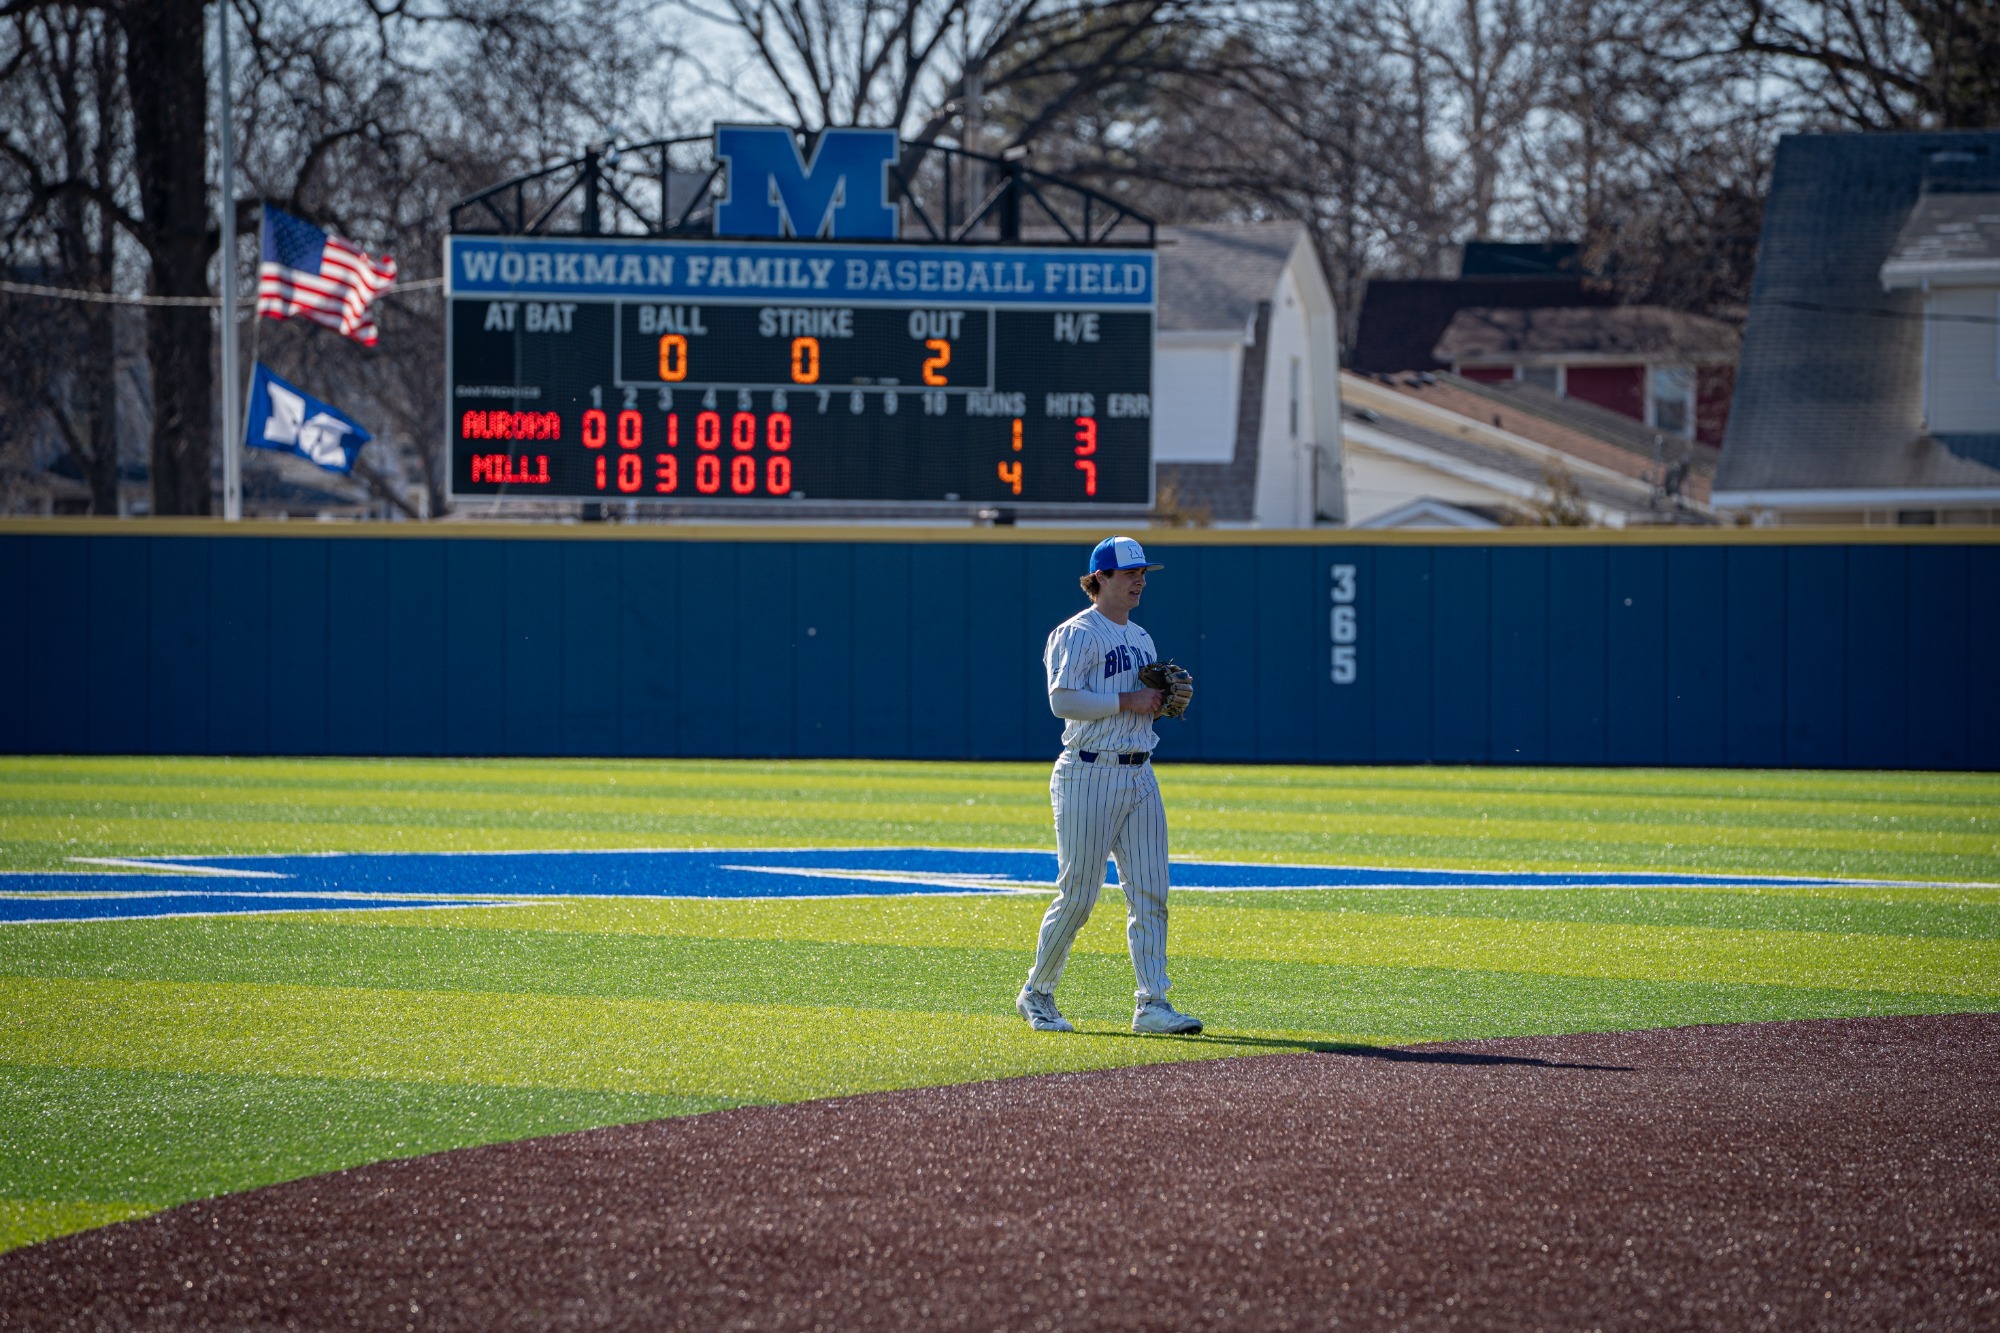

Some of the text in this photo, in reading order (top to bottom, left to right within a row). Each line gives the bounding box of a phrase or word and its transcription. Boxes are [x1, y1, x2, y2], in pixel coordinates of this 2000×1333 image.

[712, 123, 899, 239] M
[462, 251, 1148, 295] WORKMAN FAMILY BASEBALL FIELD
[484, 301, 577, 333] AT BAT
[638, 305, 708, 335] BALL
[758, 307, 854, 338] STRIKE
[908, 309, 965, 340] OUT
[1054, 312, 1100, 344] H/E
[658, 333, 688, 382] 0
[791, 336, 820, 385] 0
[922, 338, 951, 387] 2
[590, 385, 948, 416] 1 2 3 4 5 6 7 8 9 10
[965, 391, 1026, 417] RUNS
[1046, 392, 1096, 418] HITS
[1107, 393, 1150, 418] ERR
[463, 410, 560, 440] AURORA
[582, 408, 792, 451] 0 0 1 0 0 0
[1012, 418, 1023, 451] 1
[1074, 416, 1097, 456] 3
[596, 453, 792, 495] 1 0 3 0 0 0
[998, 461, 1023, 495] 4
[1074, 459, 1097, 496] 7
[1330, 563, 1357, 685] 365
[1104, 644, 1132, 679] BIG
